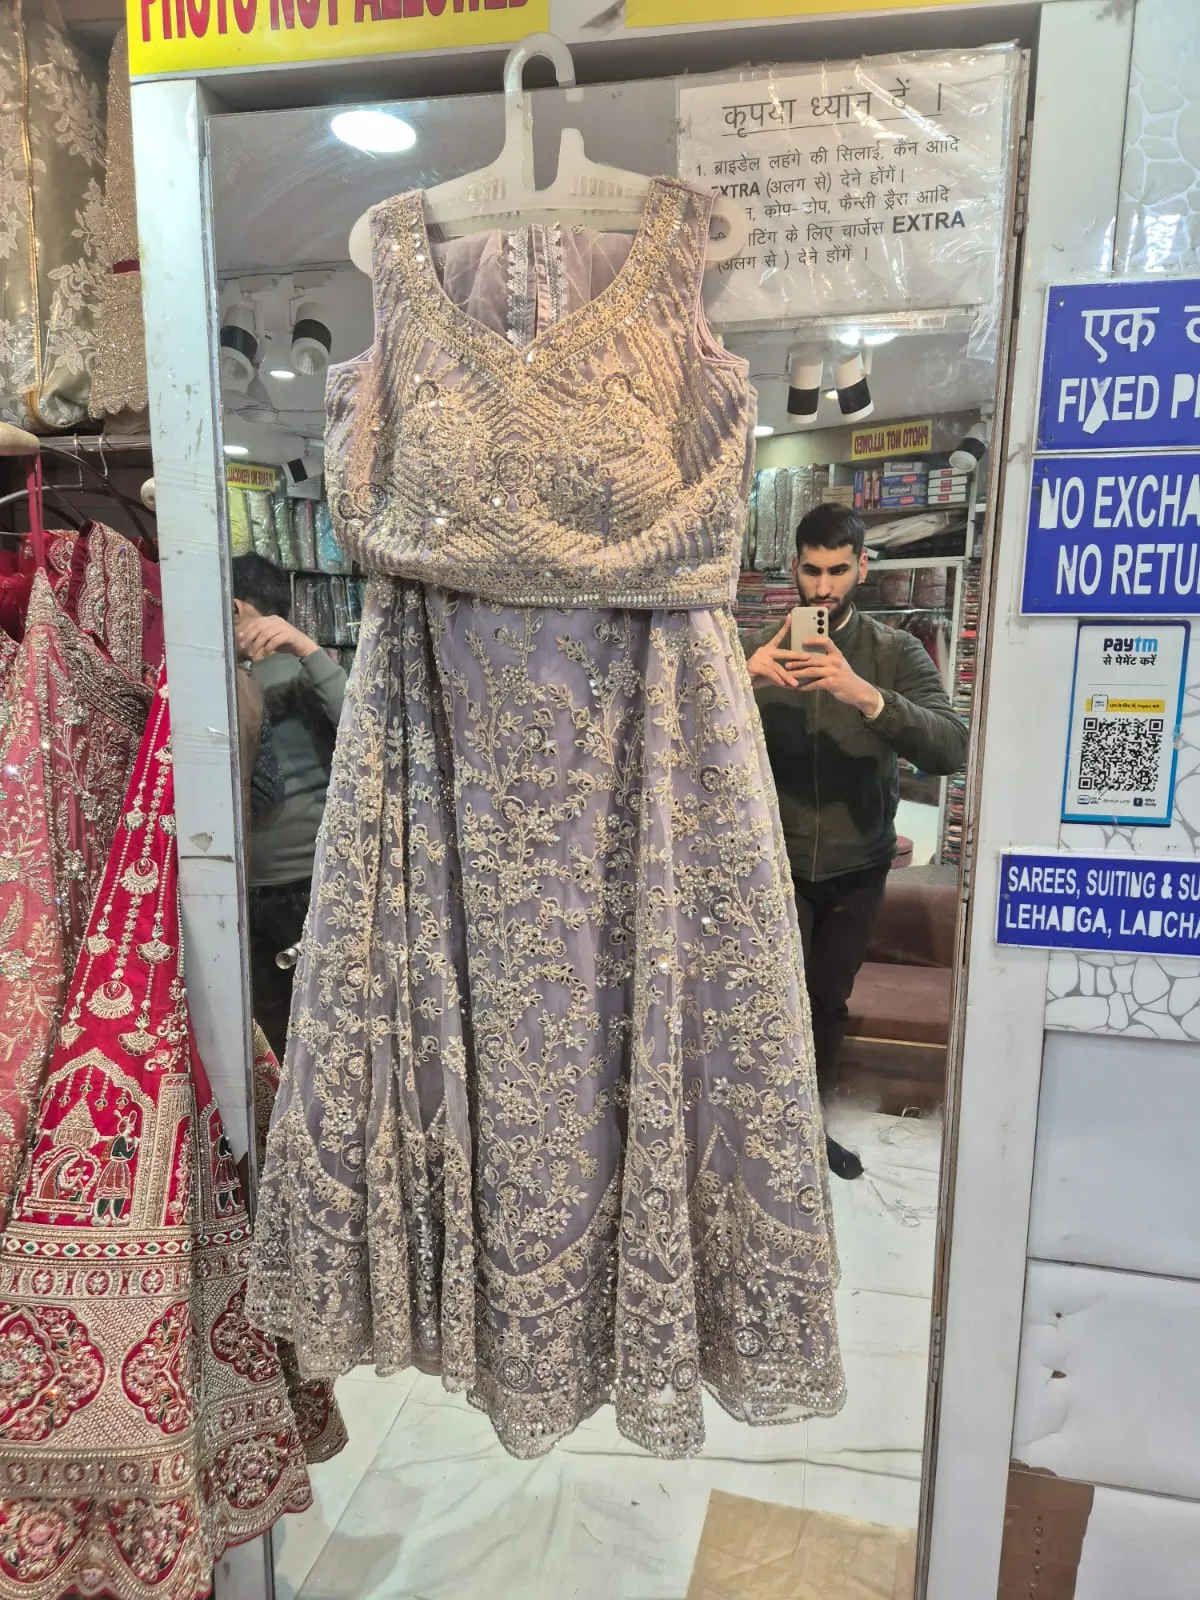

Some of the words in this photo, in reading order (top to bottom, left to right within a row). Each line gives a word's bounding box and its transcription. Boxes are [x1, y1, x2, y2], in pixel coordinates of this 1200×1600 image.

[722, 99, 797, 138] कृपया
[811, 91, 873, 119] ध्यान
[696, 164, 706, 177] 1.
[768, 148, 802, 169] लहंगे
[810, 146, 828, 166] की
[926, 134, 961, 154] आदि
[766, 177, 807, 199] (अलग
[840, 167, 862, 187] देने
[916, 184, 951, 204] आदि
[785, 223, 802, 243] के
[807, 222, 834, 242] लिए
[892, 210, 966, 234] EXTRA
[798, 246, 819, 265] देने
[1081, 306, 1160, 363] एक
[1058, 375, 1160, 433] FIXED
[1038, 477, 1085, 529] NO
[1056, 543, 1102, 595] NO
[1110, 543, 1200, 595] RETU
[1102, 653, 1112, 666] से
[1116, 653, 1137, 666] पेमेंट
[1140, 653, 1158, 666] करें
[1103, 636, 1158, 652] paytm
[1008, 865, 1081, 899] SAREES,
[1086, 868, 1156, 898] SUITING
[1161, 872, 1173, 899] &
